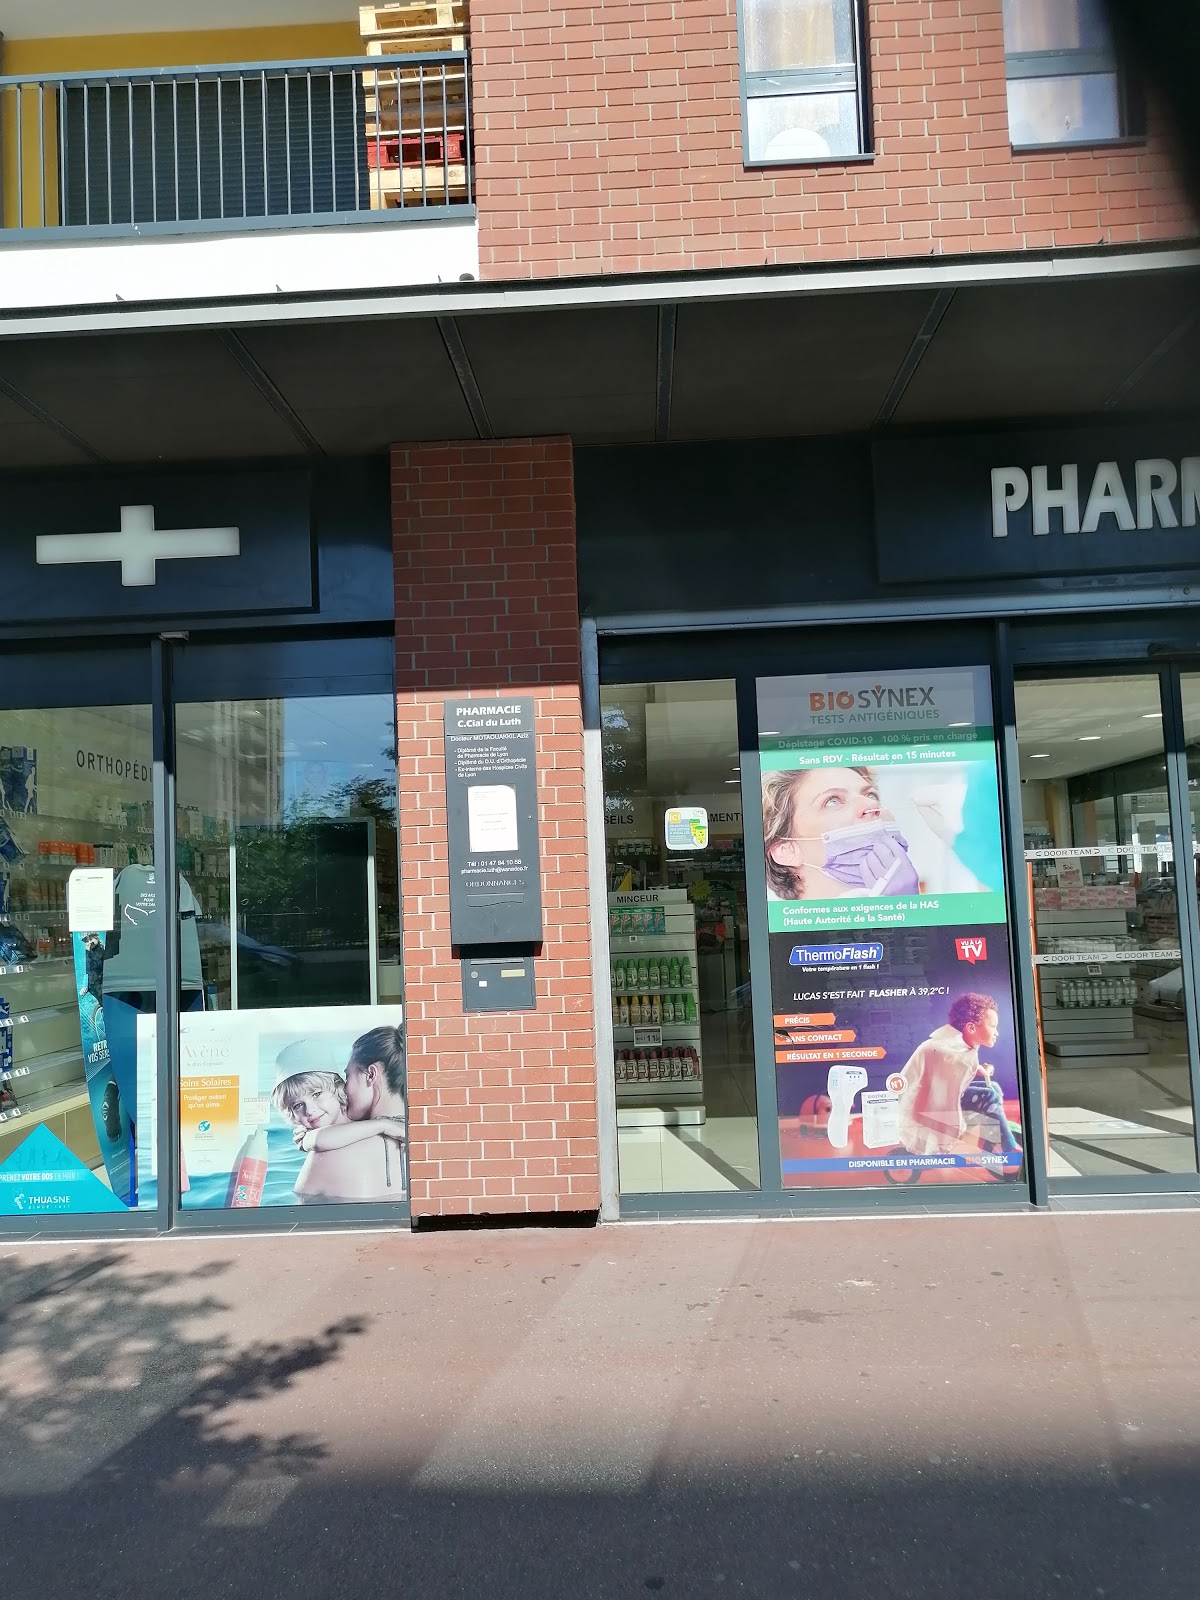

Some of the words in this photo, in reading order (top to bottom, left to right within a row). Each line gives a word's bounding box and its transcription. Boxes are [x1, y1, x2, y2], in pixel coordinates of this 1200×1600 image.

[810, 685, 935, 711] BIOSYNEX
[456, 706, 521, 716] PHARMACIE
[810, 714, 844, 724] TESTS
[849, 710, 939, 723] ANTIGÉNIQUES
[458, 719, 483, 727] C.Cial
[500, 718, 521, 726] Luth
[778, 740, 824, 749] Dépistage
[828, 736, 873, 746] COVID-19
[882, 735, 898, 743] 100
[902, 734, 910, 742] %
[914, 734, 930, 743] pris
[947, 732, 977, 742] charge
[799, 757, 820, 765] Sans
[823, 755, 843, 763] RDV
[852, 753, 889, 761] Résultat
[906, 751, 917, 759] 15
[920, 750, 956, 759] minutes
[77, 749, 152, 782] ORTHOPÉDI
[616, 894, 659, 903] MINCEUR
[783, 906, 830, 915] Conformes
[851, 904, 894, 913] exigences
[896, 901, 907, 910] de
[910, 901, 917, 909] la
[920, 901, 939, 909] HAS
[784, 917, 812, 926] (Haute
[815, 915, 851, 924] Autorité
[854, 914, 865, 923] de
[868, 914, 875, 922] la
[878, 913, 905, 922] Santé)
[796, 947, 877, 961] ThermoFlash
[961, 944, 982, 958] TV
[793, 992, 821, 1001] LUCAS
[822, 990, 845, 1000] S'EST
[847, 990, 865, 998] FAIT
[869, 988, 908, 997] FLASHER
[909, 986, 916, 995] À
[808, 1034, 842, 1042] CONTACT
[181, 1045, 229, 1058] Avène
[842, 1050, 877, 1058] SECONDE
[180, 1079, 199, 1087] Soins
[202, 1078, 231, 1086] Solaires
[184, 1094, 207, 1102] Protéger
[188, 1102, 204, 1110] qu'on
[849, 1160, 894, 1168] DISPONIBLE
[909, 1158, 955, 1166] PHARMACIE
[966, 1156, 1008, 1164] BIOSYNEX
[42, 1172, 53, 1180] DOS
[28, 1196, 70, 1204] THUASNE
